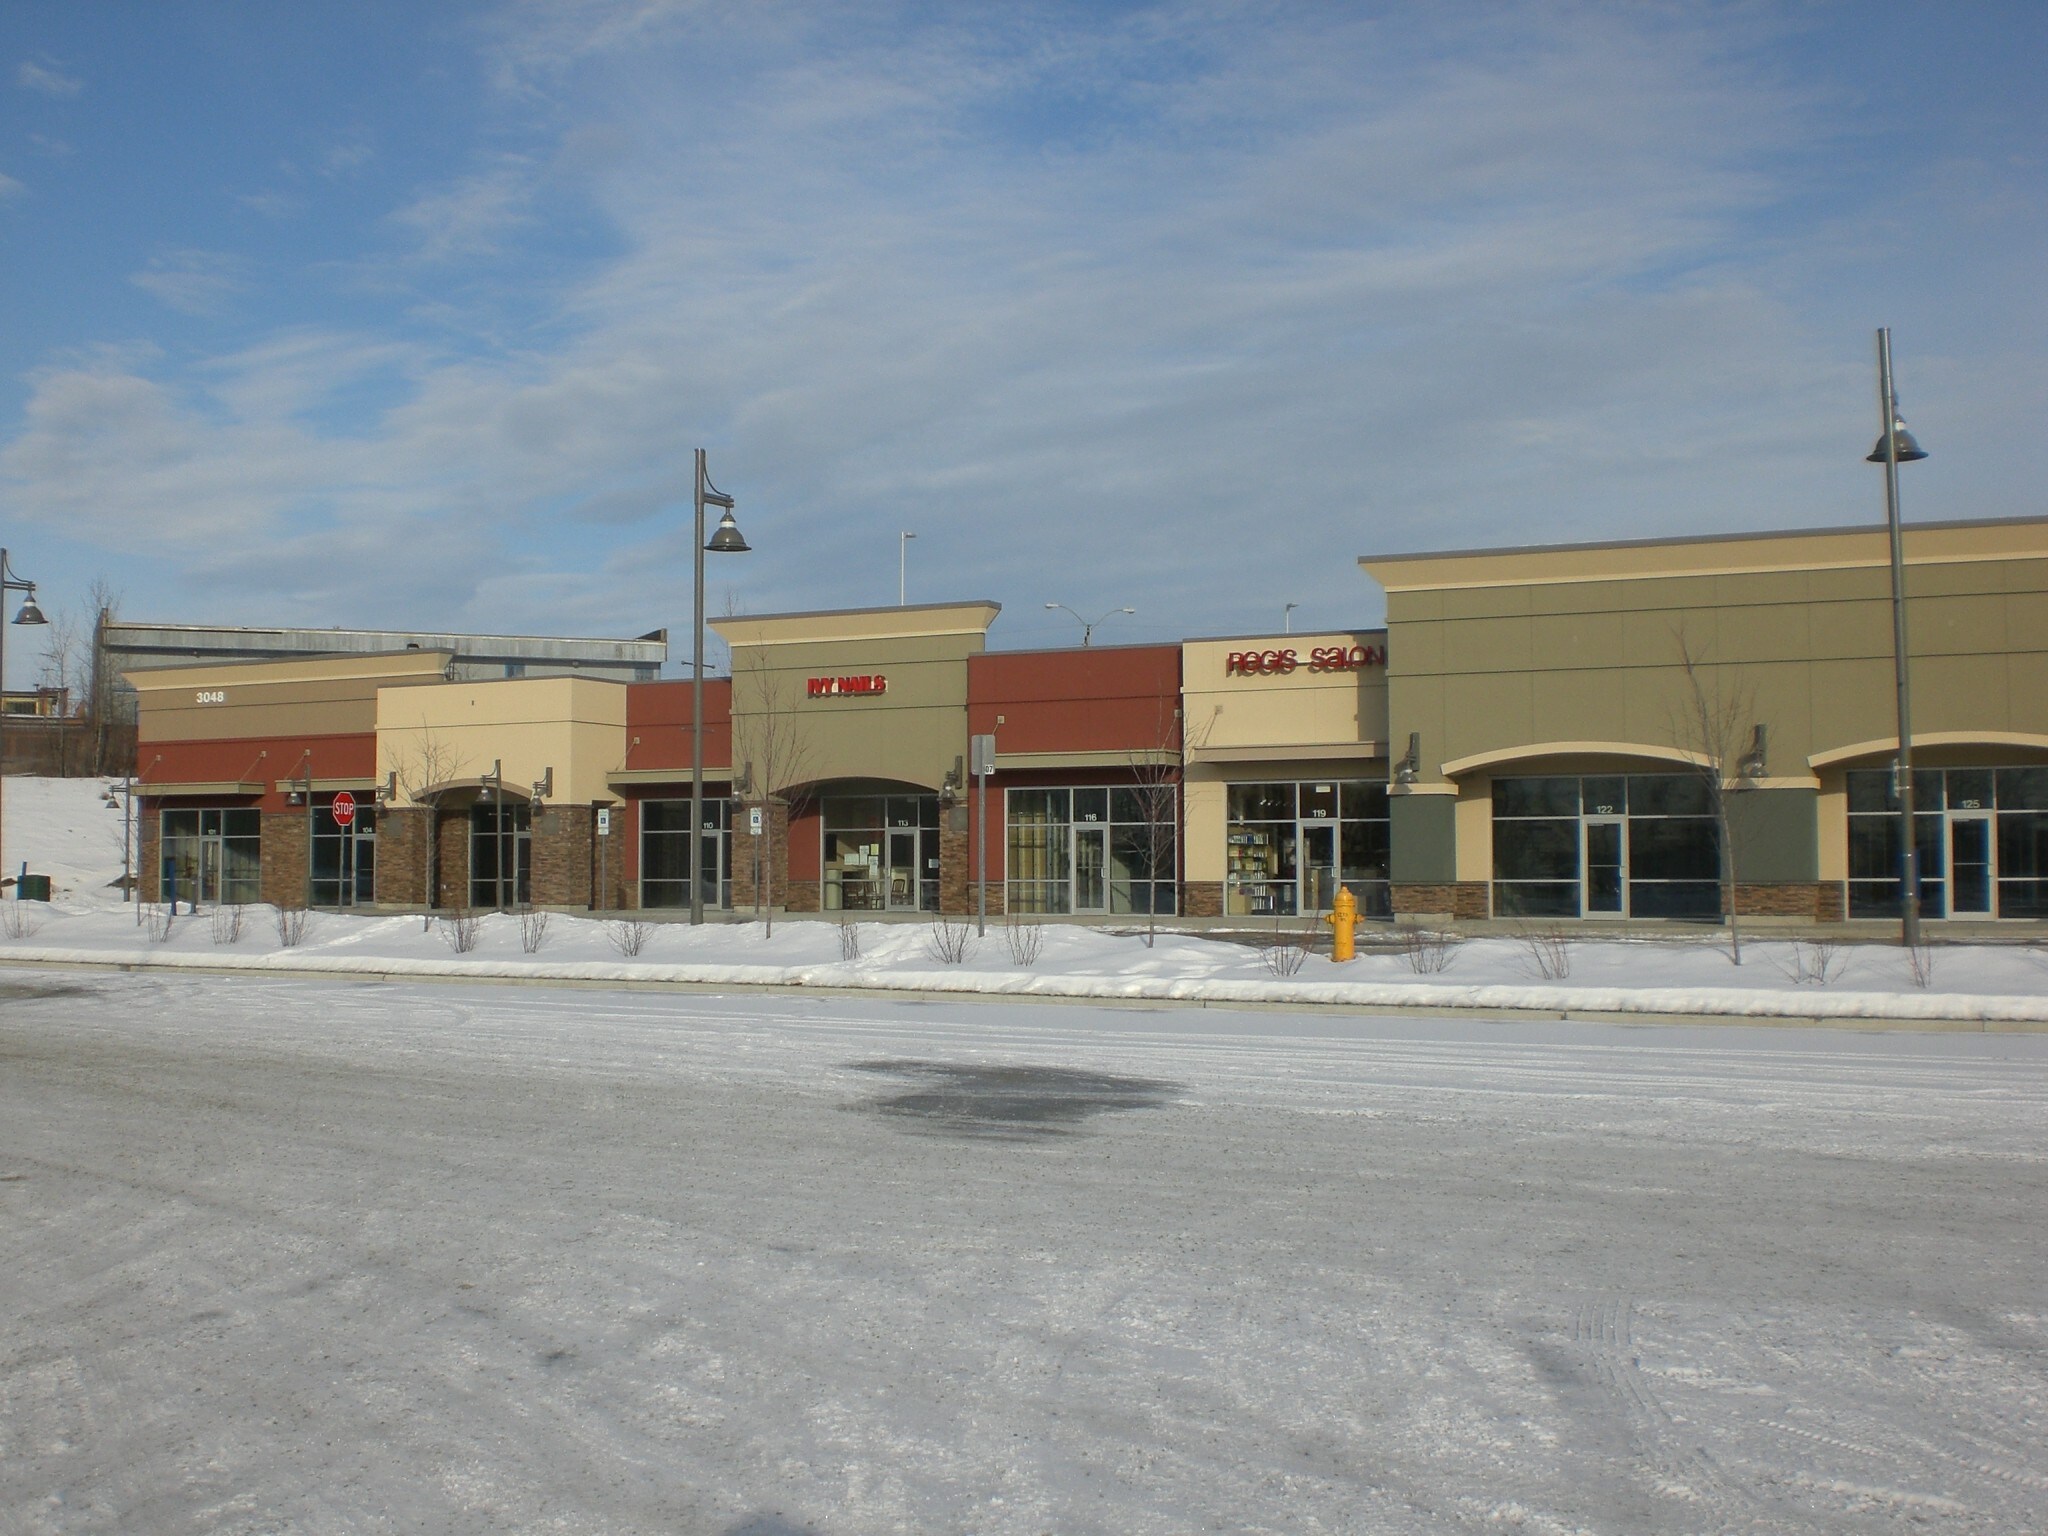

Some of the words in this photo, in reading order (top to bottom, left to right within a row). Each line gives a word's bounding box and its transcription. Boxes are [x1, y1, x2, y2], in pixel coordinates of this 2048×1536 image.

[808, 677, 834, 695] IVY
[837, 675, 886, 693] NAILS
[196, 691, 224, 703] 3048
[335, 802, 354, 815] STOP
[1962, 799, 1981, 809] 125
[1312, 809, 1327, 818] 119
[1596, 805, 1613, 814] 122
[1085, 813, 1098, 822] 116
[898, 819, 909, 827] 113
